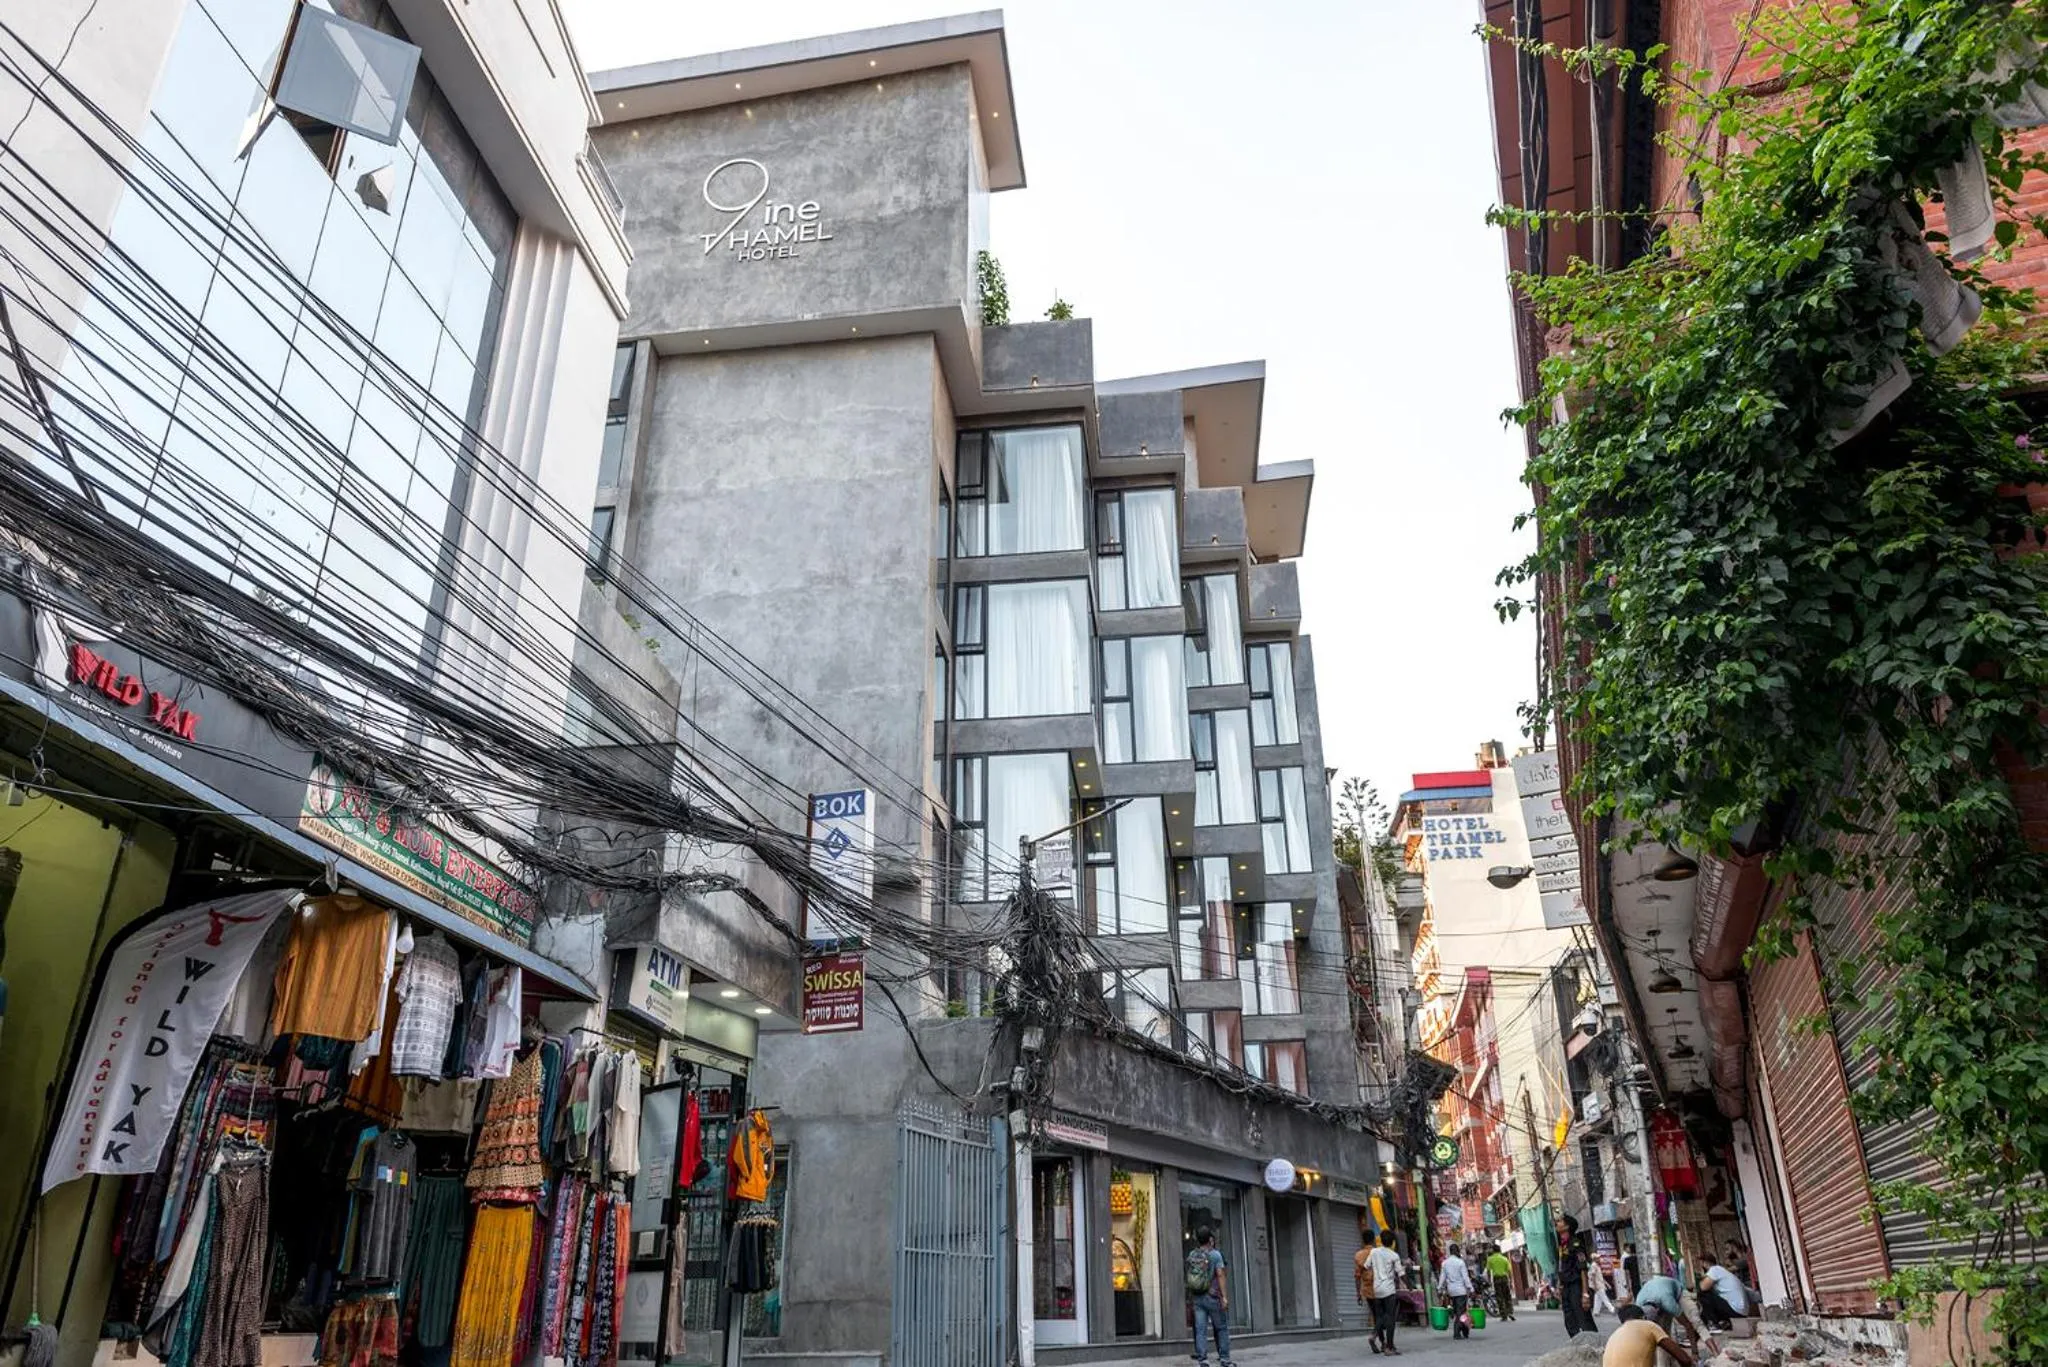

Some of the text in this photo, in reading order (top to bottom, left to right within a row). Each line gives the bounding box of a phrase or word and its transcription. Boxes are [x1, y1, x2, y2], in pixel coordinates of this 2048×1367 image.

[700, 222, 834, 257] THAMEL
[738, 246, 800, 263] HOTEL
[70, 642, 203, 743] WILD YAK
[815, 794, 862, 818] BOK
[1424, 816, 1489, 832] HOTEL
[1427, 831, 1507, 846] THAMEL
[1429, 846, 1483, 862] PARK
[1541, 875, 1575, 888] FITNESS
[647, 948, 682, 990] ATM
[102, 956, 216, 1164] WILD YAK
